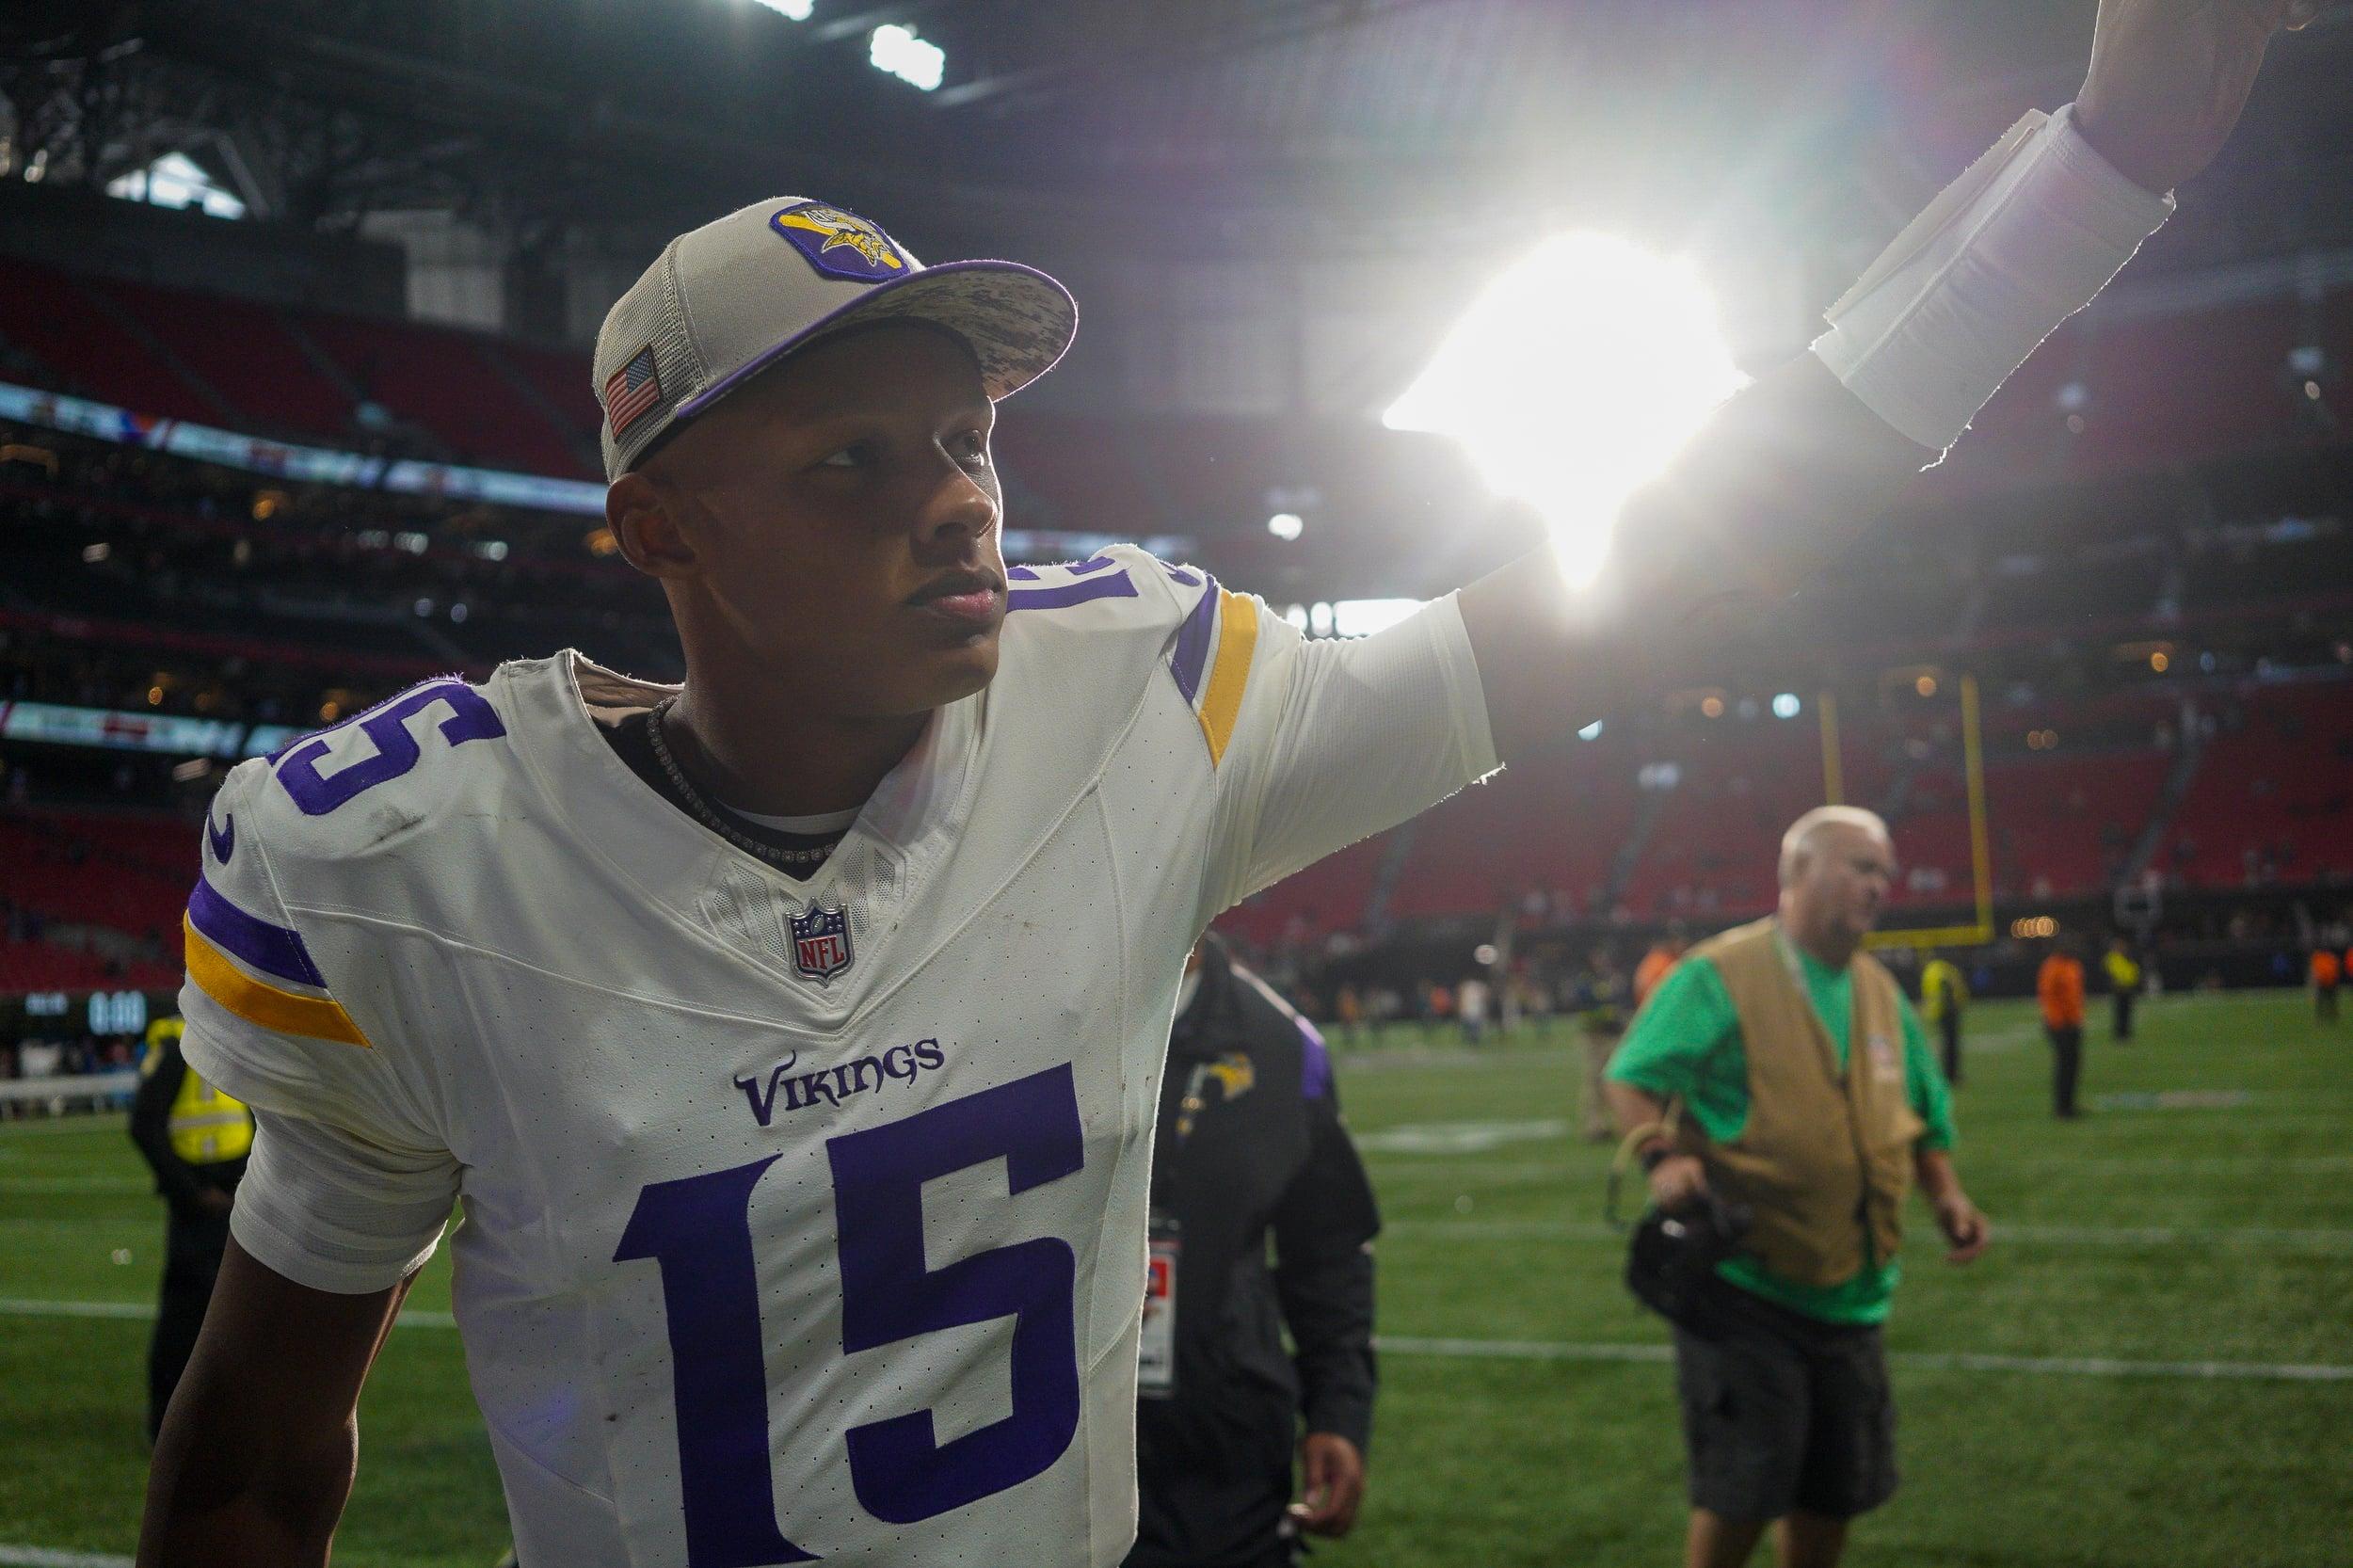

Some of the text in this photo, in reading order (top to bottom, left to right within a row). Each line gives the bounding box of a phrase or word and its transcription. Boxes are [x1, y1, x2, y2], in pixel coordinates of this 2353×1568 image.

[264, 676, 506, 816] 5
[799, 936, 845, 969] NFL
[733, 1037, 945, 1127] VIKINGS
[612, 1062, 1084, 1568] 15
